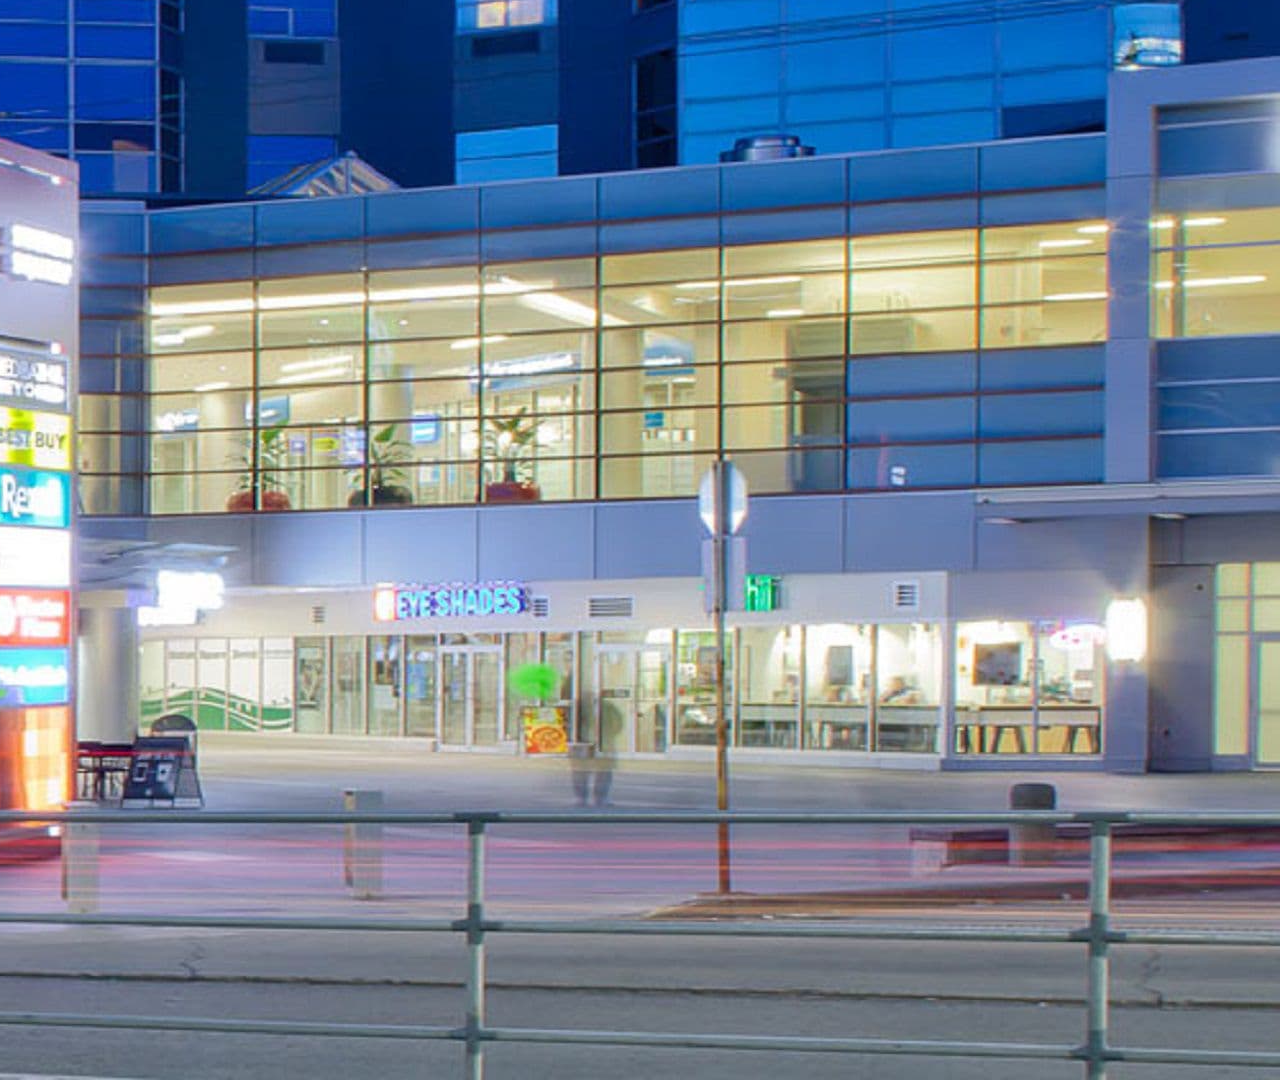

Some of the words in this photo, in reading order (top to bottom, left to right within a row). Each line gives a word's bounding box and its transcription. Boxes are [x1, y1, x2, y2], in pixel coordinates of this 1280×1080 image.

[35, 431, 68, 451] BUY
[397, 589, 433, 619] EYE
[435, 587, 522, 617] SHADES
